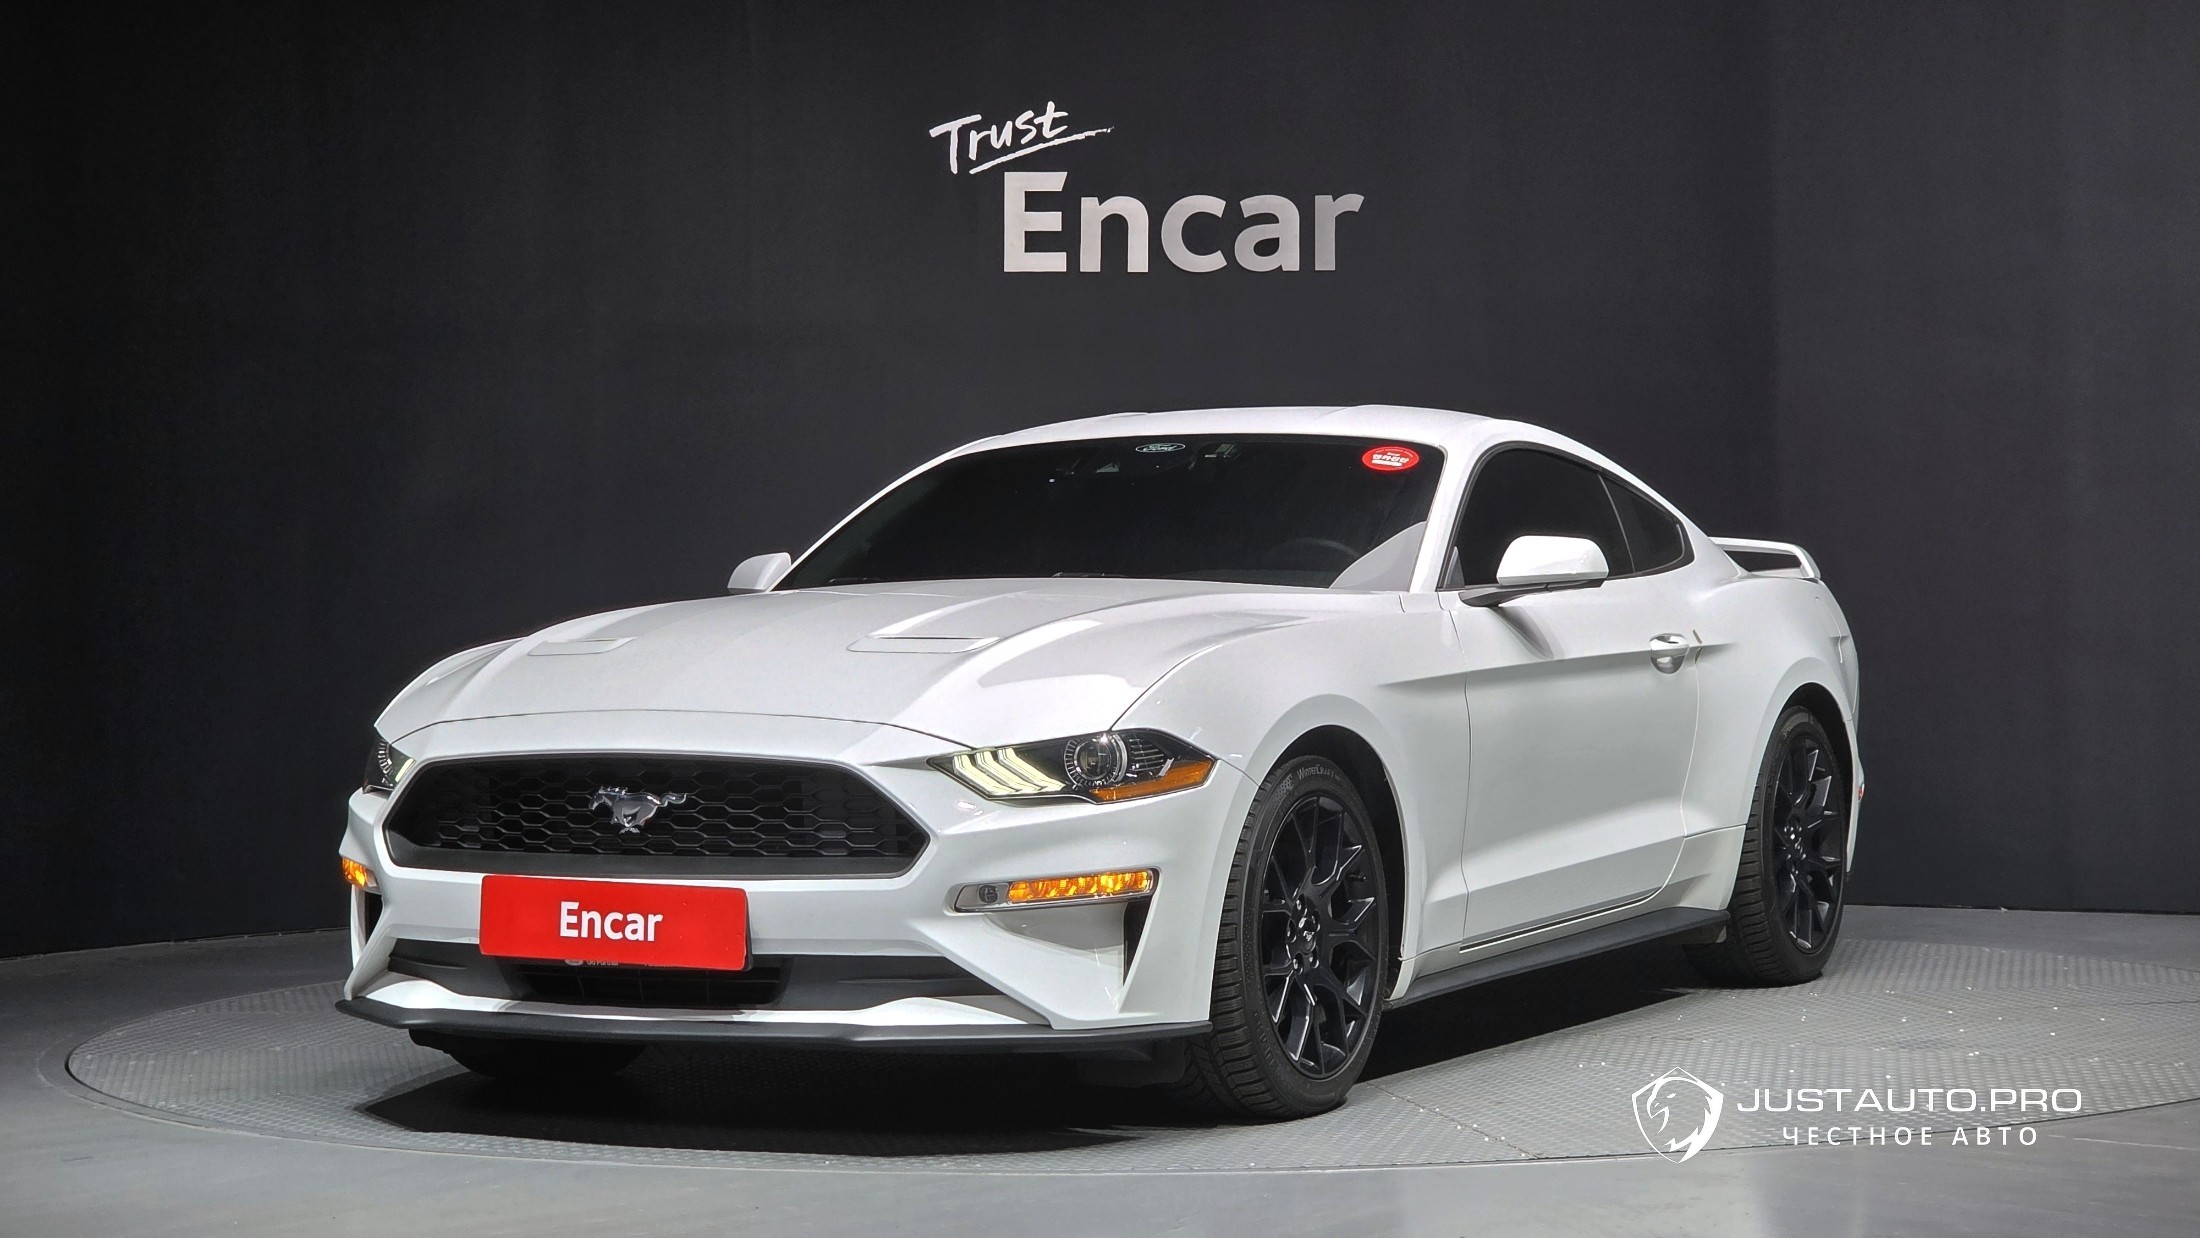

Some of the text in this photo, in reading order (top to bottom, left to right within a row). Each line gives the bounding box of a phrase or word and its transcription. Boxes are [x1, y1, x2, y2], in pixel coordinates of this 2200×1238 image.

[929, 101, 1069, 175] Trust
[1003, 171, 1365, 273] Encar
[559, 901, 664, 942] Encar
